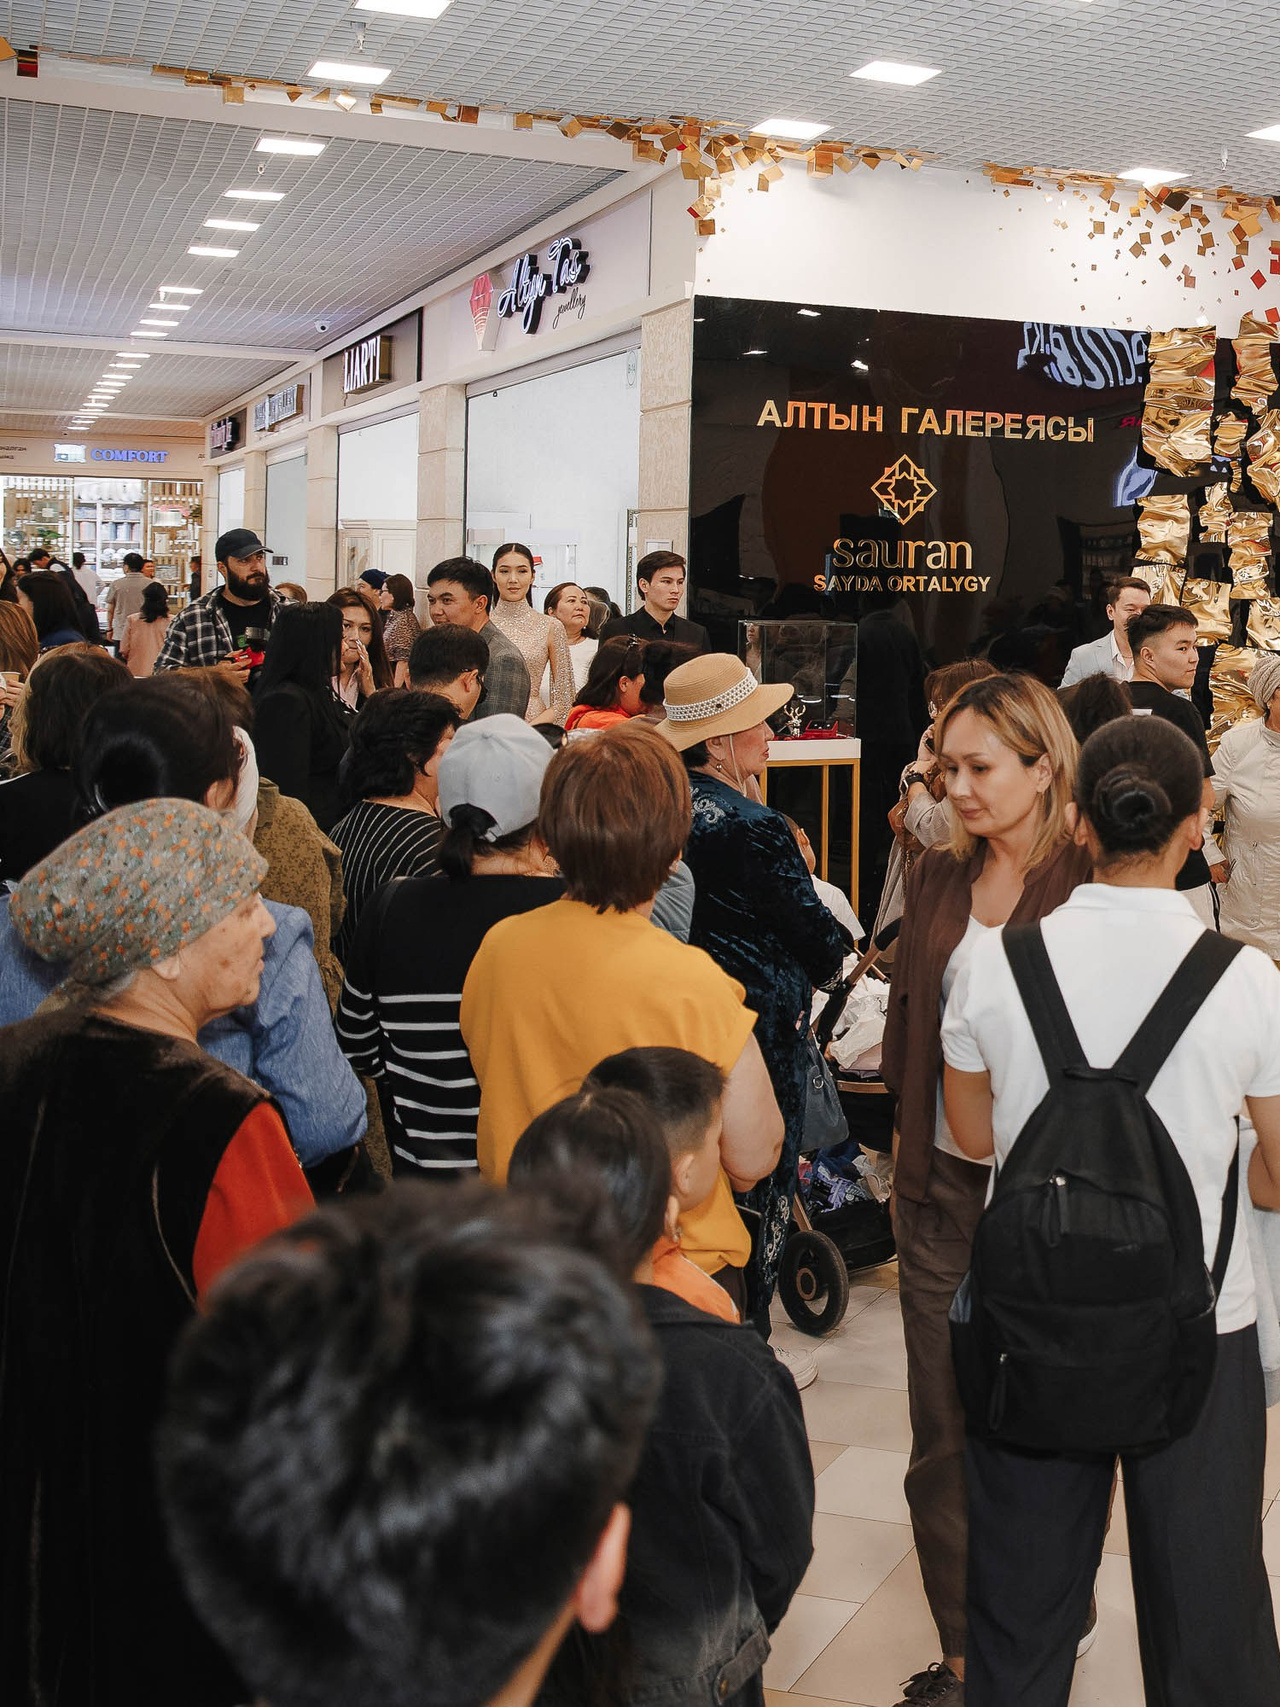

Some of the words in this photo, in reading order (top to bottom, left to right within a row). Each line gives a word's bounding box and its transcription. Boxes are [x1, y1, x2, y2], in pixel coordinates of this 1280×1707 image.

[498, 253, 550, 335] Altyn
[548, 236, 587, 294] Tas
[756, 399, 884, 433] АЛТЫН
[900, 406, 1095, 443] ГАЛЕРЕЯСЫ
[90, 449, 169, 464] COMFORT
[832, 537, 973, 570] sauran
[813, 574, 883, 592] SAYDA
[887, 575, 992, 593] ORTALYGY
